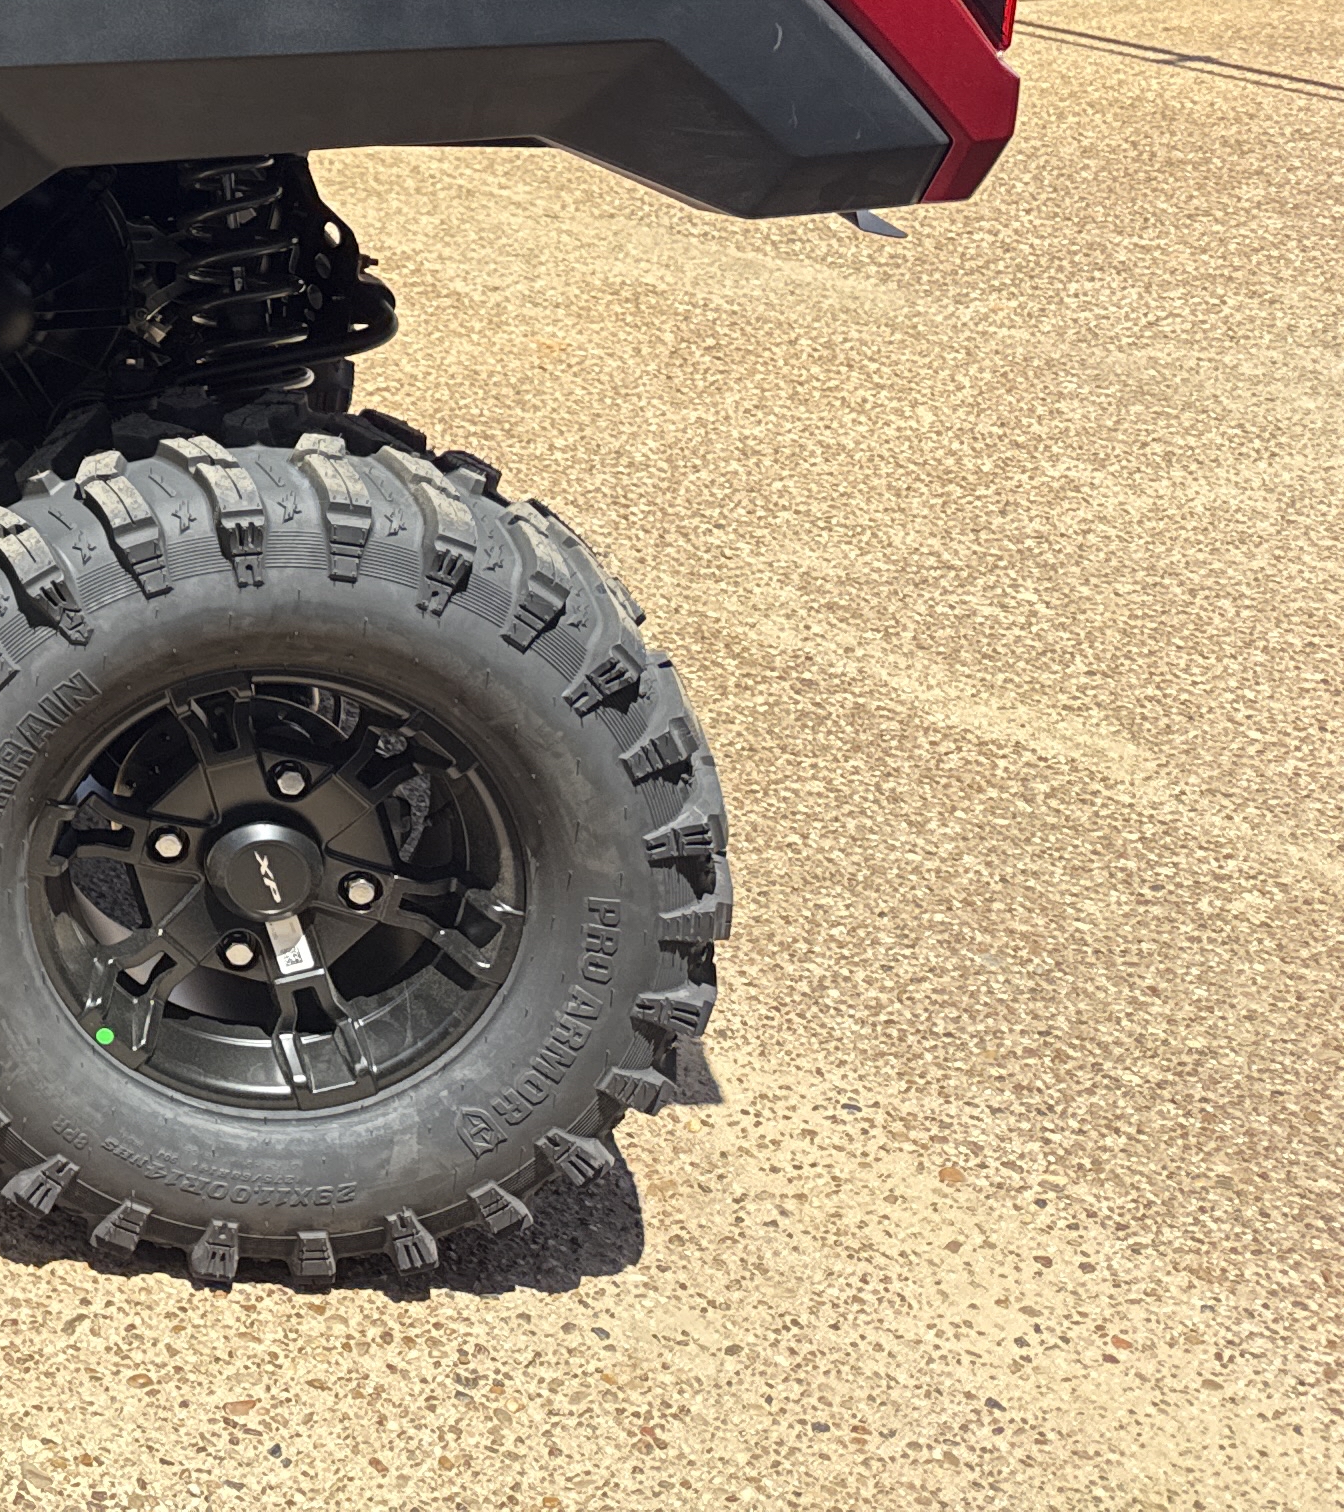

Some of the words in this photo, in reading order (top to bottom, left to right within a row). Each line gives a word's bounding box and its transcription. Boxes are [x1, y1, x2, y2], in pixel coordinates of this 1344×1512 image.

[253, 850, 282, 904] XP
[581, 896, 621, 985] PRO
[492, 984, 603, 1126] ARMOR
